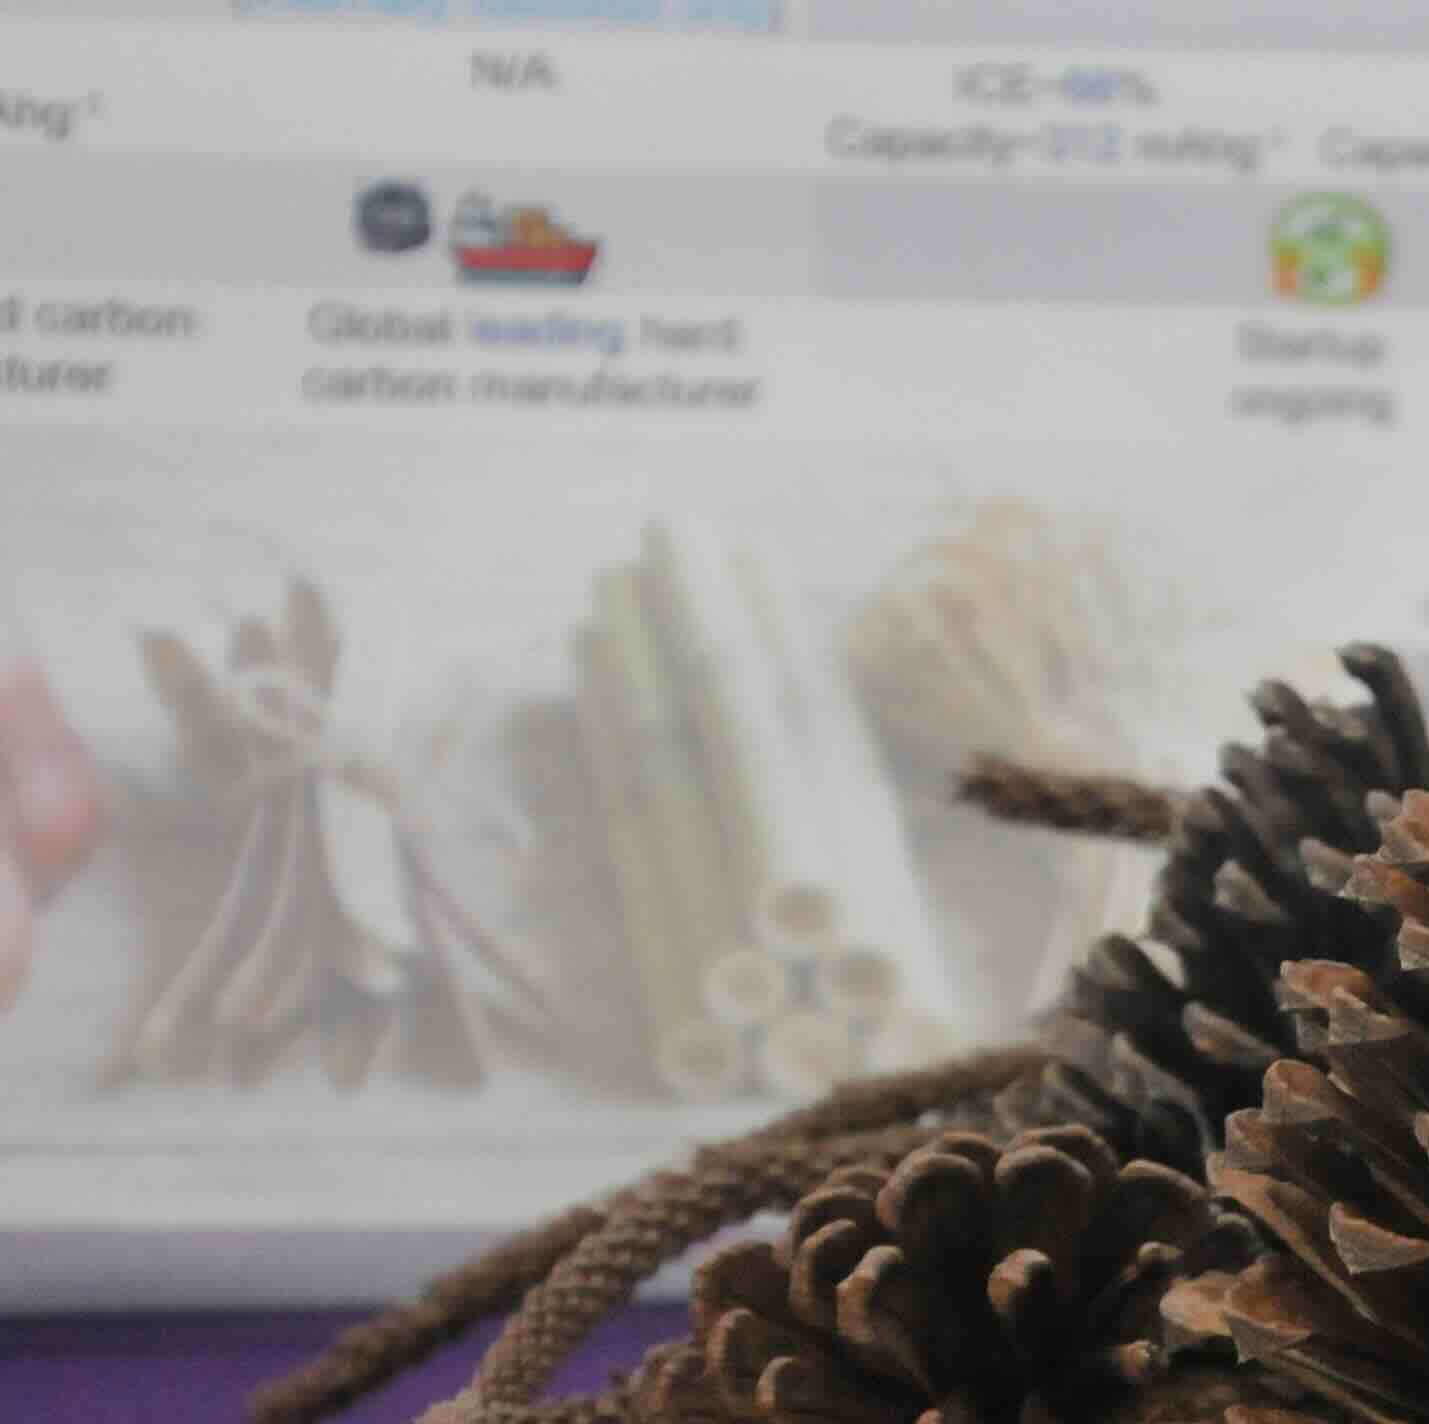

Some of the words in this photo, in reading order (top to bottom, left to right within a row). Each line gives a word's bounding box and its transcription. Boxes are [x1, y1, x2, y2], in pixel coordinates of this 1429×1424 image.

[470, 51, 558, 90] N/A
[34, 298, 200, 340] carbon
[306, 300, 455, 345] Global
[467, 309, 626, 356] leading
[1235, 322, 1386, 370] Startup
[300, 365, 456, 402] carbon
[470, 370, 760, 410] manufacturer
